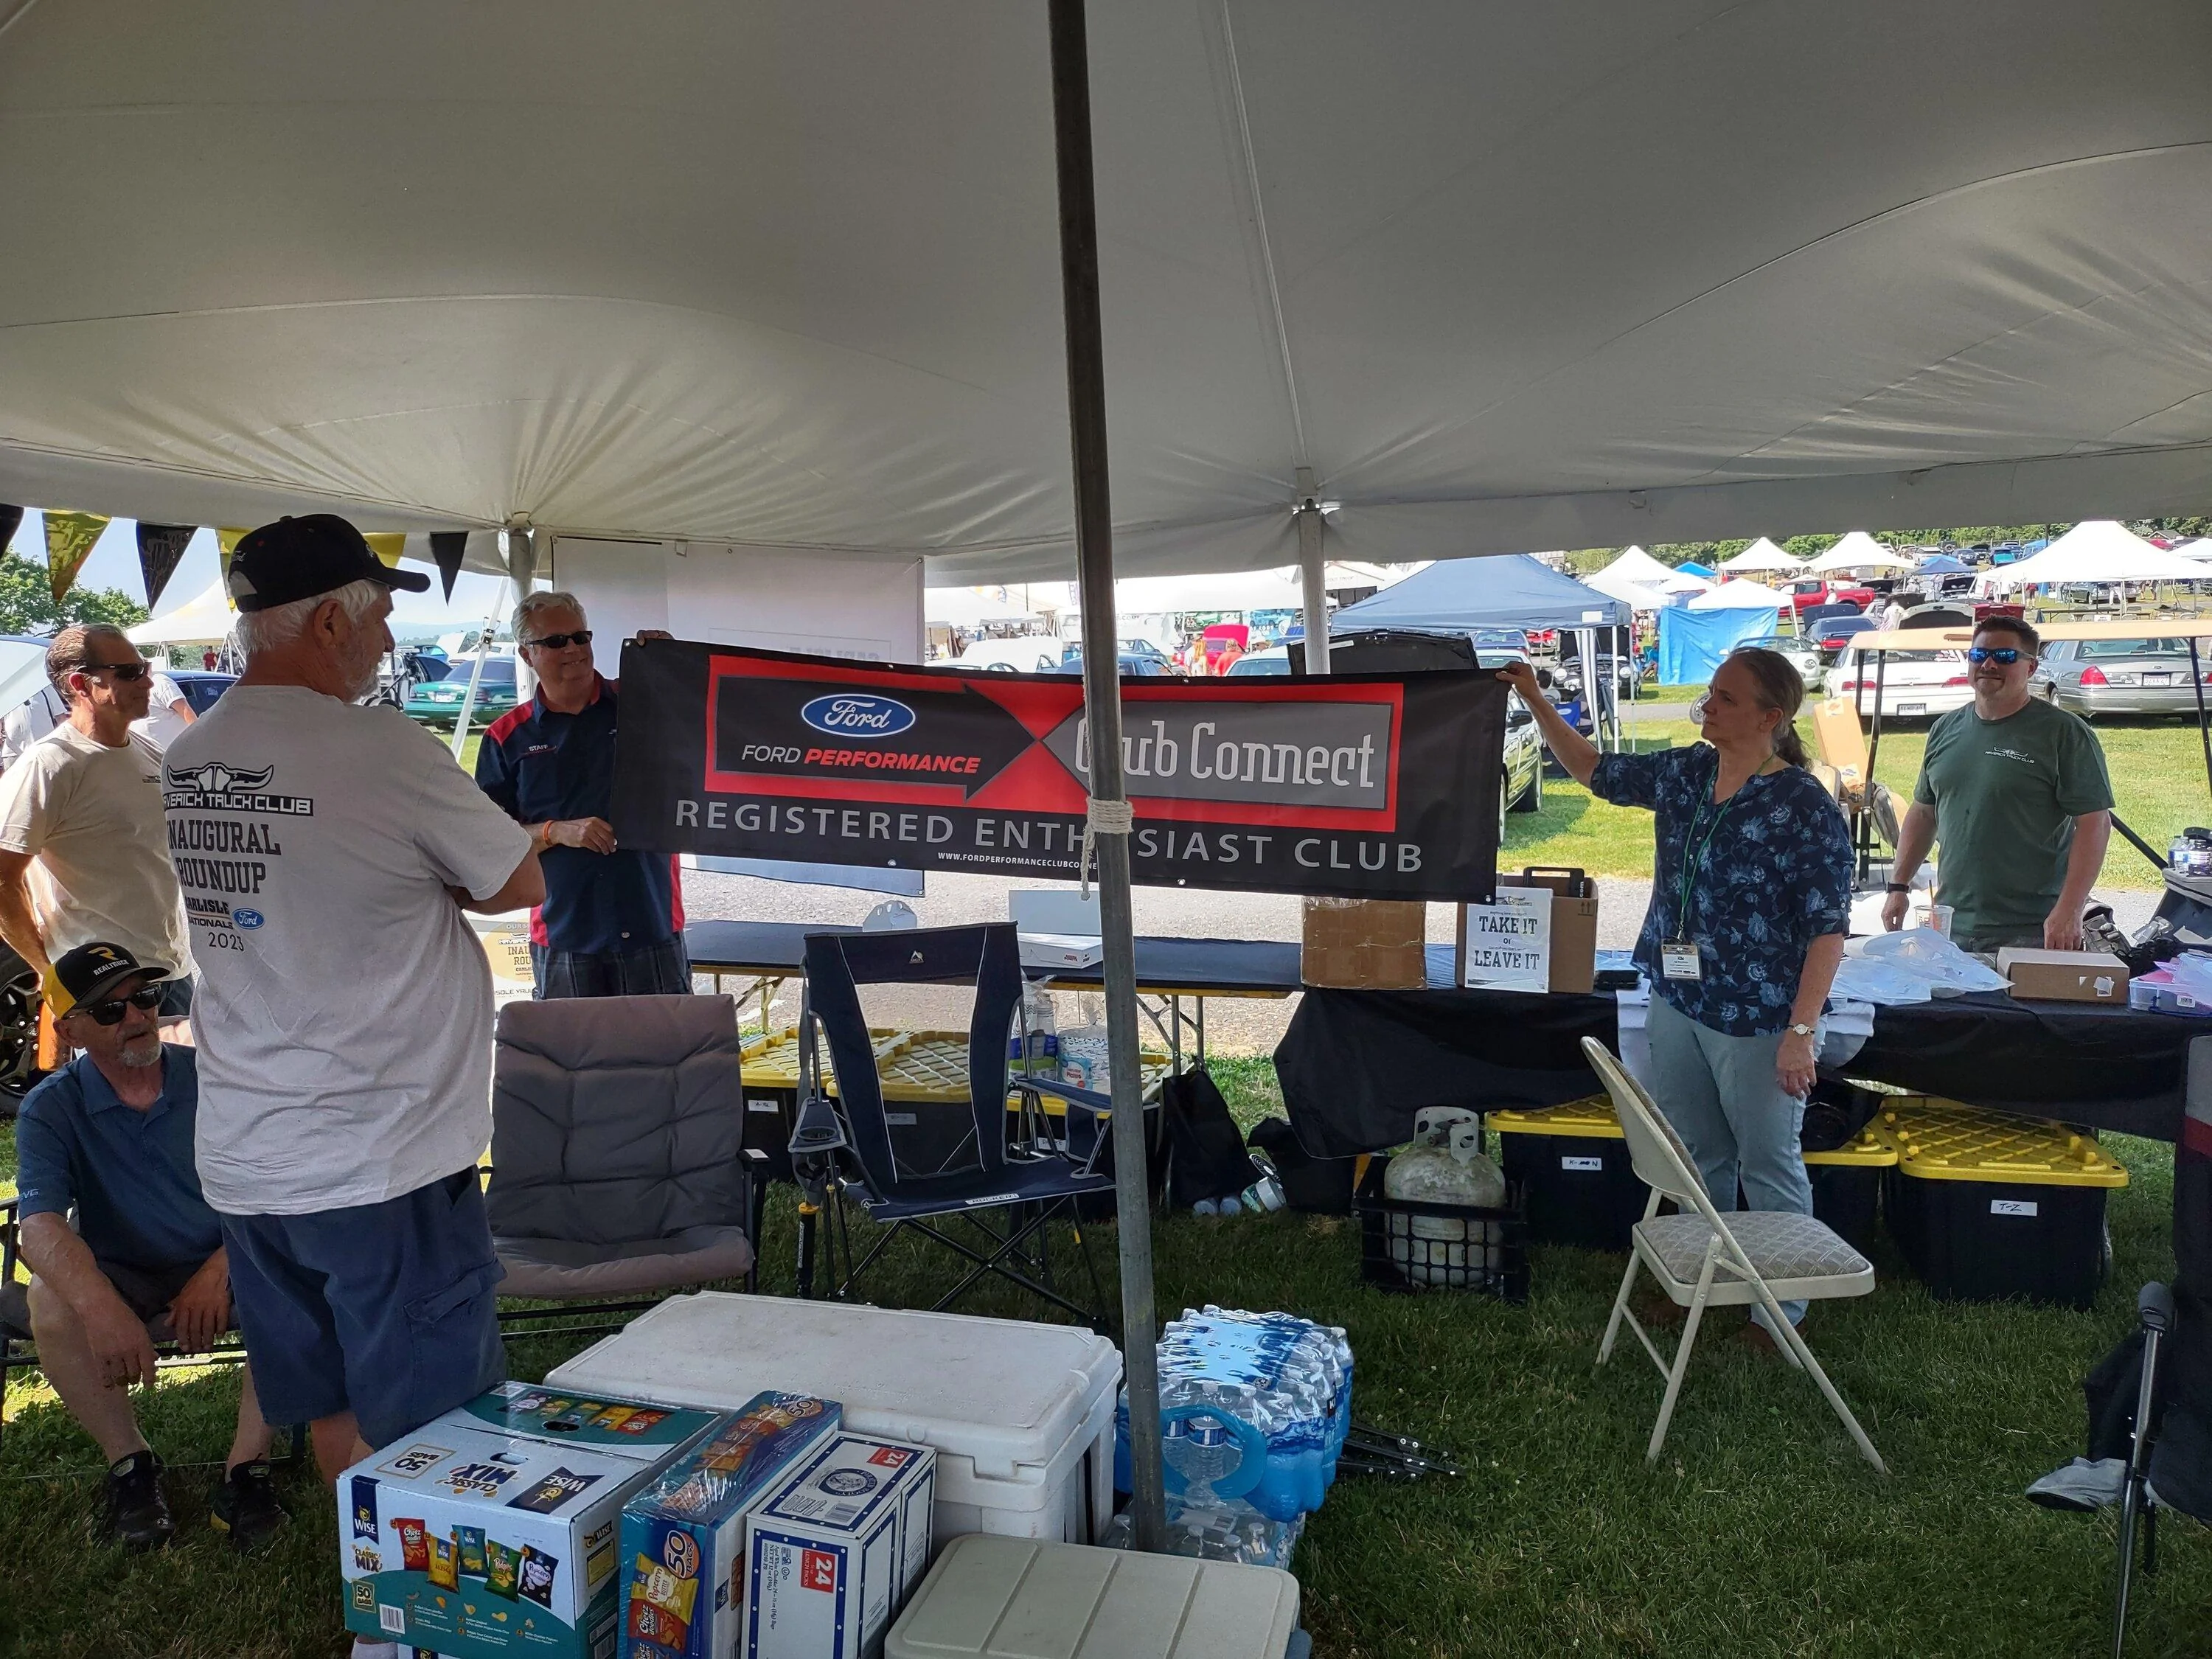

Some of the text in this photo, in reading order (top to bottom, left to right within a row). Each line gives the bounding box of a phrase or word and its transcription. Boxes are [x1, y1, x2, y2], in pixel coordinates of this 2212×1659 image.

[824, 700, 892, 728] Ford
[528, 744, 549, 752] STAFF
[1075, 719, 1374, 788] Cub Connect
[741, 744, 981, 774] FORD PERFORMANCE
[206, 793, 251, 810] TRUCK
[254, 795, 311, 815] CLUB
[675, 799, 1422, 872] REGISTERED ENTHSIAST CLUB
[175, 857, 266, 894] ROUNDUP
[240, 912, 257, 925] Ford
[507, 922, 524, 930] OUR
[1479, 915, 1537, 935] TAKE IT
[208, 931, 244, 952] 2023
[93, 959, 129, 975] REALTRUCK
[1474, 950, 1540, 970] LEAVE IT
[790, 1401, 812, 1417] 50
[394, 1457, 428, 1472] 50
[408, 1451, 441, 1461] BAGS
[883, 1453, 905, 1465] 24
[456, 1462, 518, 1485] MIX
[444, 1477, 498, 1492] CLASSIC
[543, 1475, 587, 1492] WISE
[354, 1518, 377, 1534] WISE
[404, 1527, 421, 1536] Cheez
[596, 1523, 611, 1540] WISE
[355, 1548, 378, 1559] CLASSIC
[667, 1530, 687, 1579] 50
[769, 1555, 774, 1565] WT
[355, 1555, 380, 1573] MIX
[815, 1557, 832, 1585] 24
[356, 1585, 371, 1599] 50
[647, 1567, 664, 1601] Popcorn
[639, 1604, 649, 1635] Cheez
[647, 1607, 655, 1635] doodles
